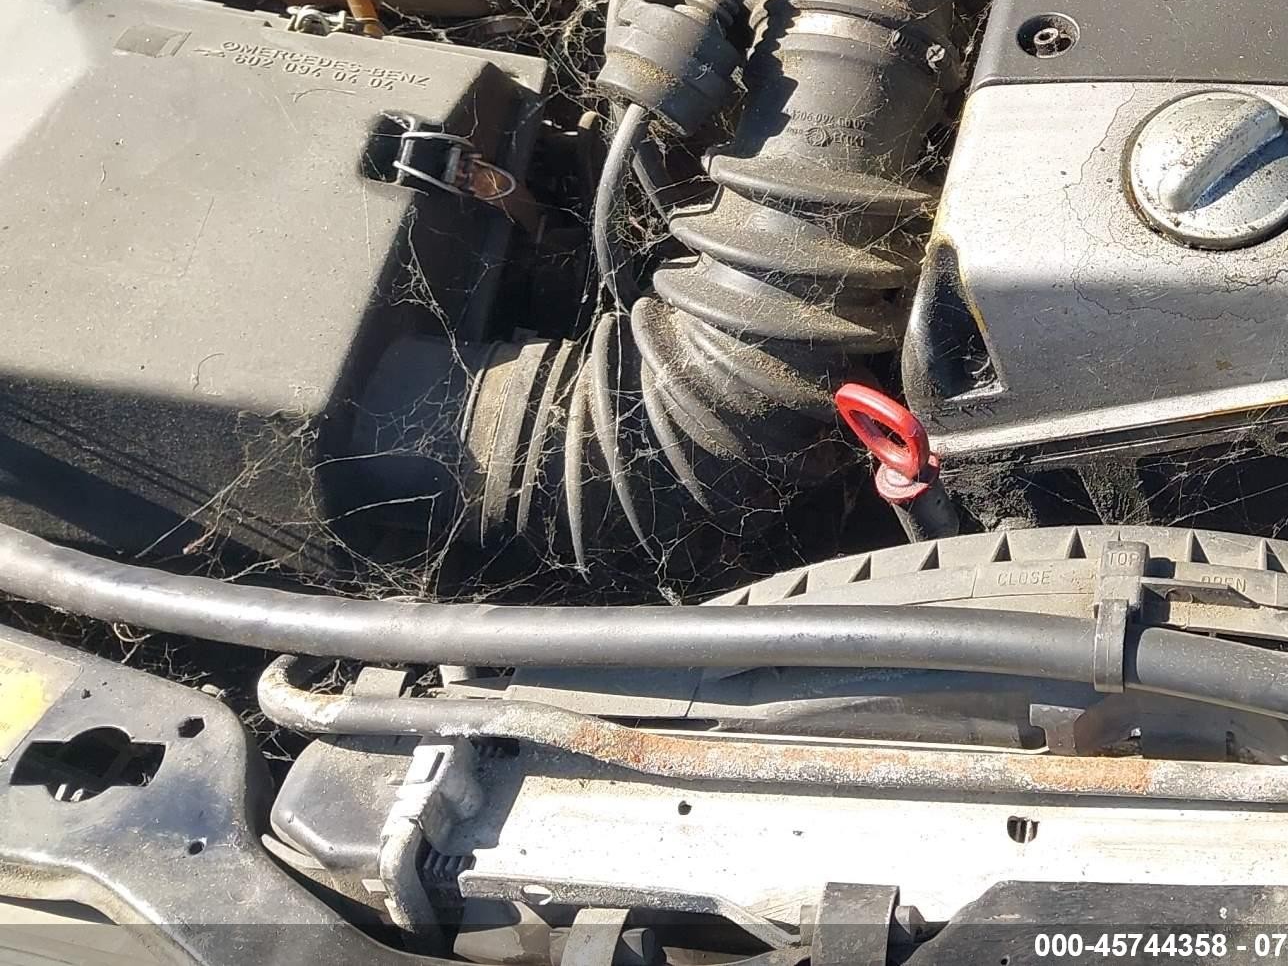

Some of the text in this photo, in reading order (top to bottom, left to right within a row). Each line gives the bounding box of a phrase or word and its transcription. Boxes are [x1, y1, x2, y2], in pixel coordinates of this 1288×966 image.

[239, 42, 432, 89] MERCEDES-BENZ
[1106, 550, 1140, 567] TOP
[997, 569, 1052, 588] CLOSE
